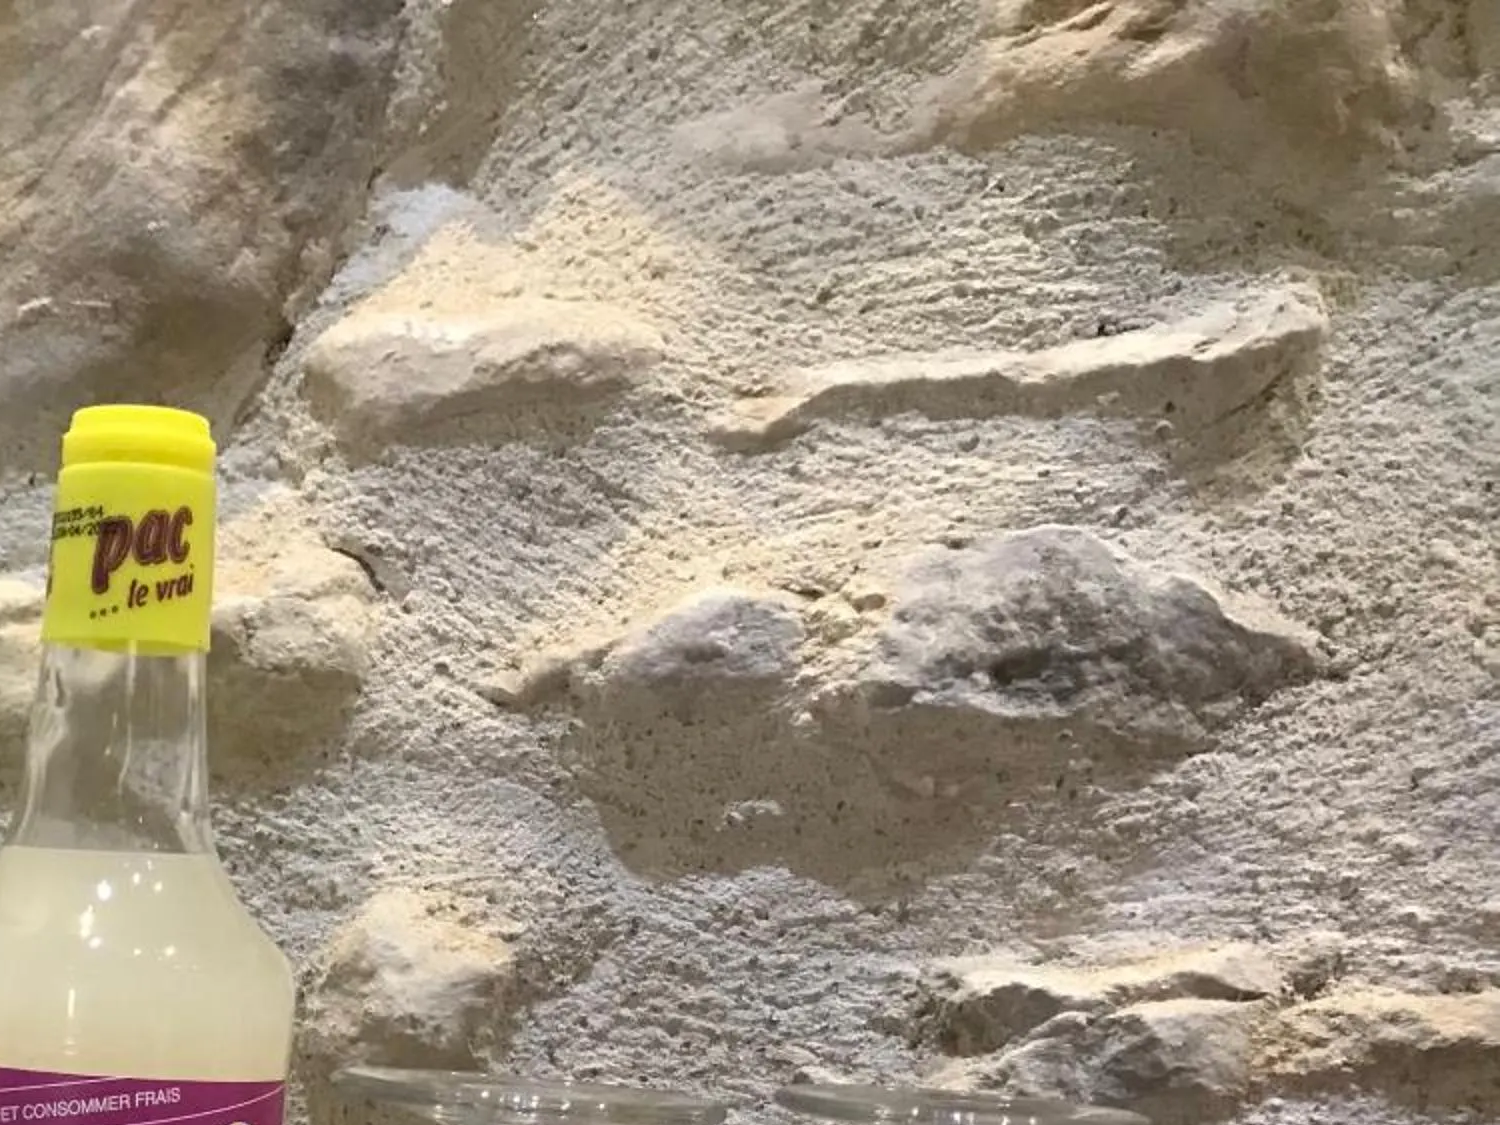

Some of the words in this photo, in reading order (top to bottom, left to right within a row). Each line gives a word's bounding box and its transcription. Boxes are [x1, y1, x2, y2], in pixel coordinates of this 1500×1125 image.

[91, 505, 193, 595] pac
[128, 579, 149, 608] le
[156, 563, 195, 602] vrai
[0, 1105, 19, 1122] ET
[22, 1094, 132, 1121] CONSOMMER
[134, 1087, 181, 1109] FRAIS
